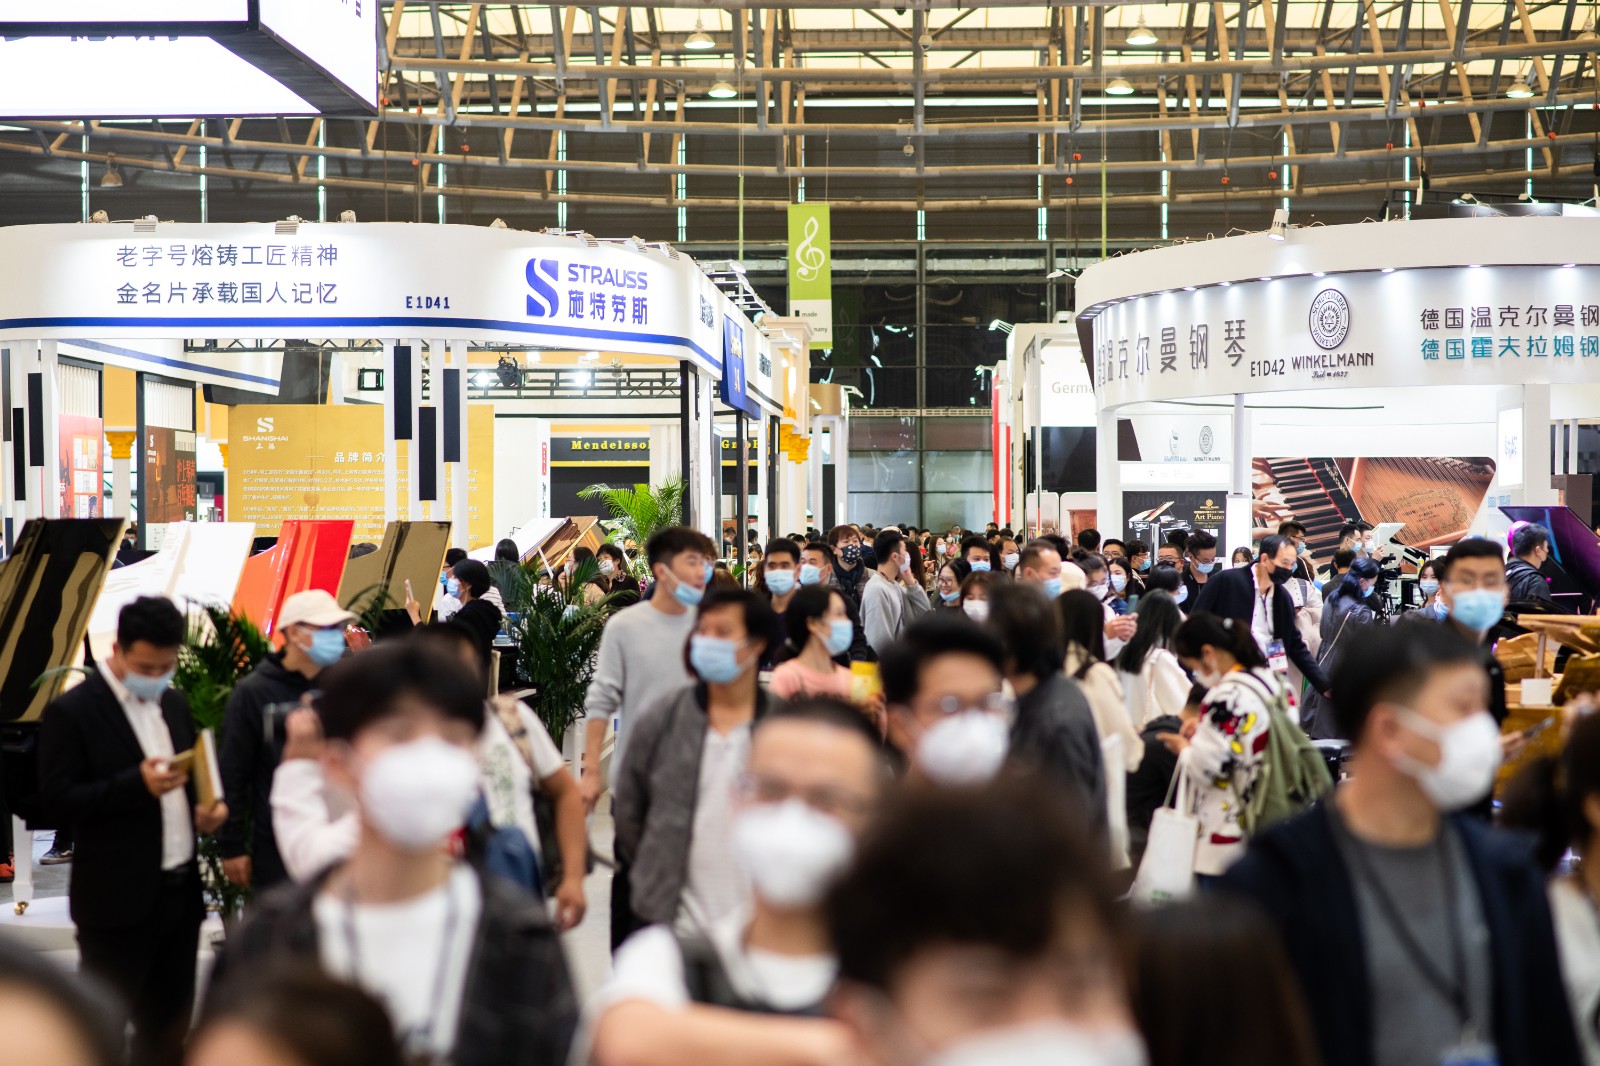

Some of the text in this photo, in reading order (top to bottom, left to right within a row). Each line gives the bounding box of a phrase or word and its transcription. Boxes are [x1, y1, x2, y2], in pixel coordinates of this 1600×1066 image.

[116, 244, 338, 267] 老字号熔铸工匠精神
[568, 263, 648, 291] STRAUSS
[116, 281, 338, 304] 金名片承载国人记忆
[406, 296, 450, 309] E1D41
[568, 289, 648, 326] 施特劳斯
[1420, 304, 1600, 330] 德国温克尔曼钢
[1313, 326, 1347, 347] WINKELMANN
[1420, 335, 1600, 361] 德国霍夫拉姆钢
[1250, 359, 1285, 378] E1D42
[1291, 352, 1374, 370] WINKELMANN
[1052, 381, 1094, 395] Germa
